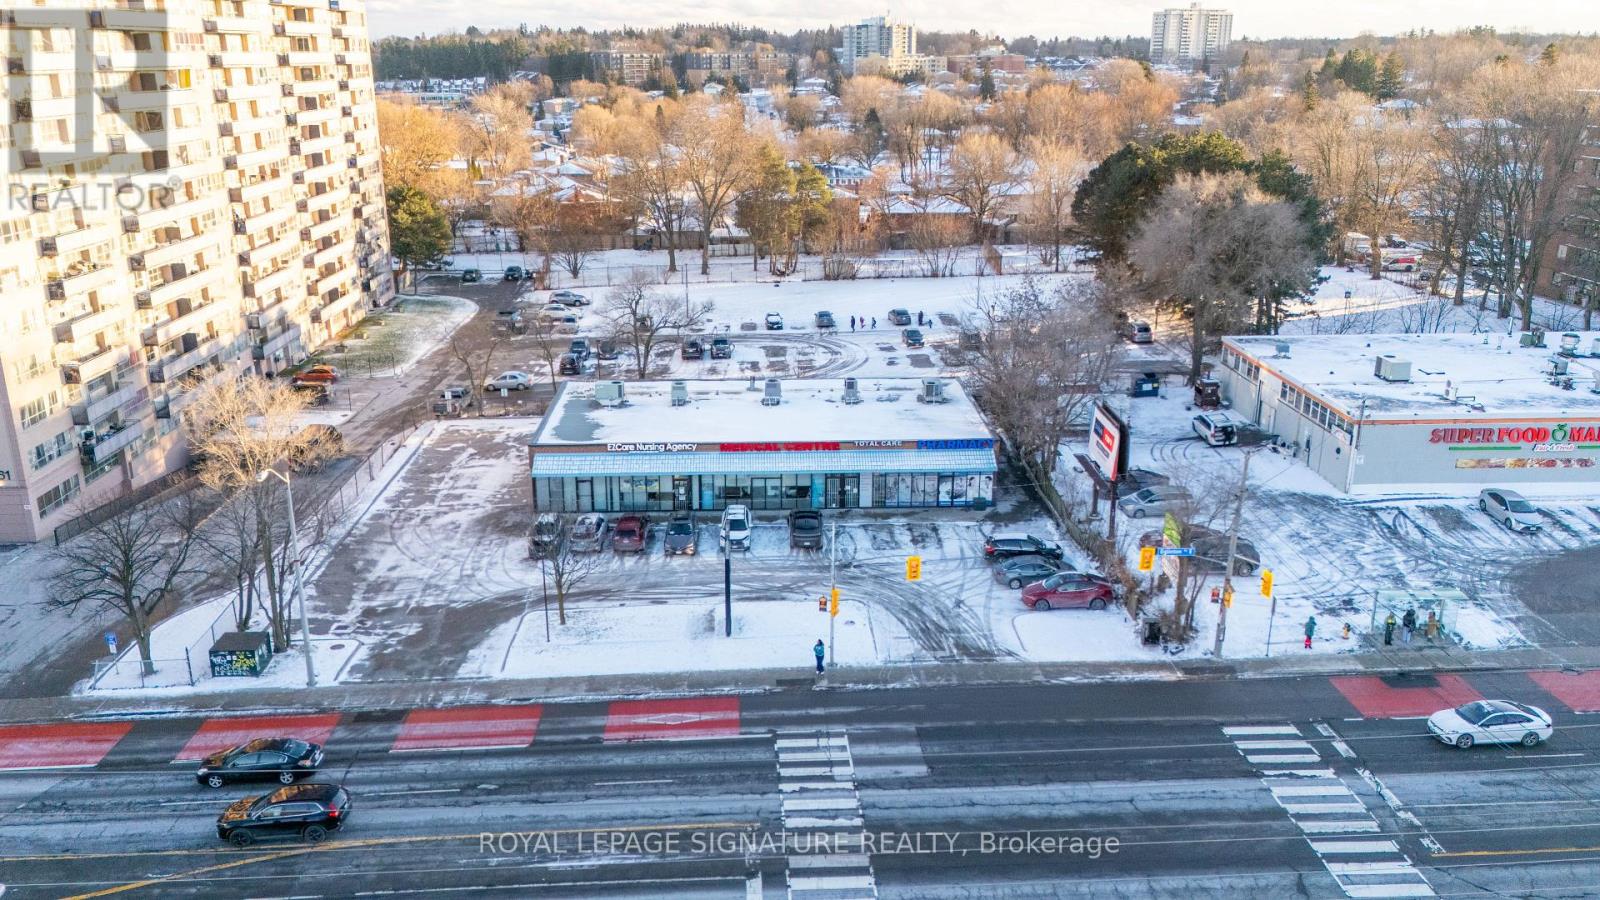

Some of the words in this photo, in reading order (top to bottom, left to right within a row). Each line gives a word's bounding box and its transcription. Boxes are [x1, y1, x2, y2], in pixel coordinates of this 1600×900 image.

[1429, 427, 1495, 443] SUPER
[1497, 427, 1550, 443] FOOD
[636, 443, 665, 452] Nursing
[666, 442, 697, 451] Agency
[918, 439, 993, 450] PHARMACY
